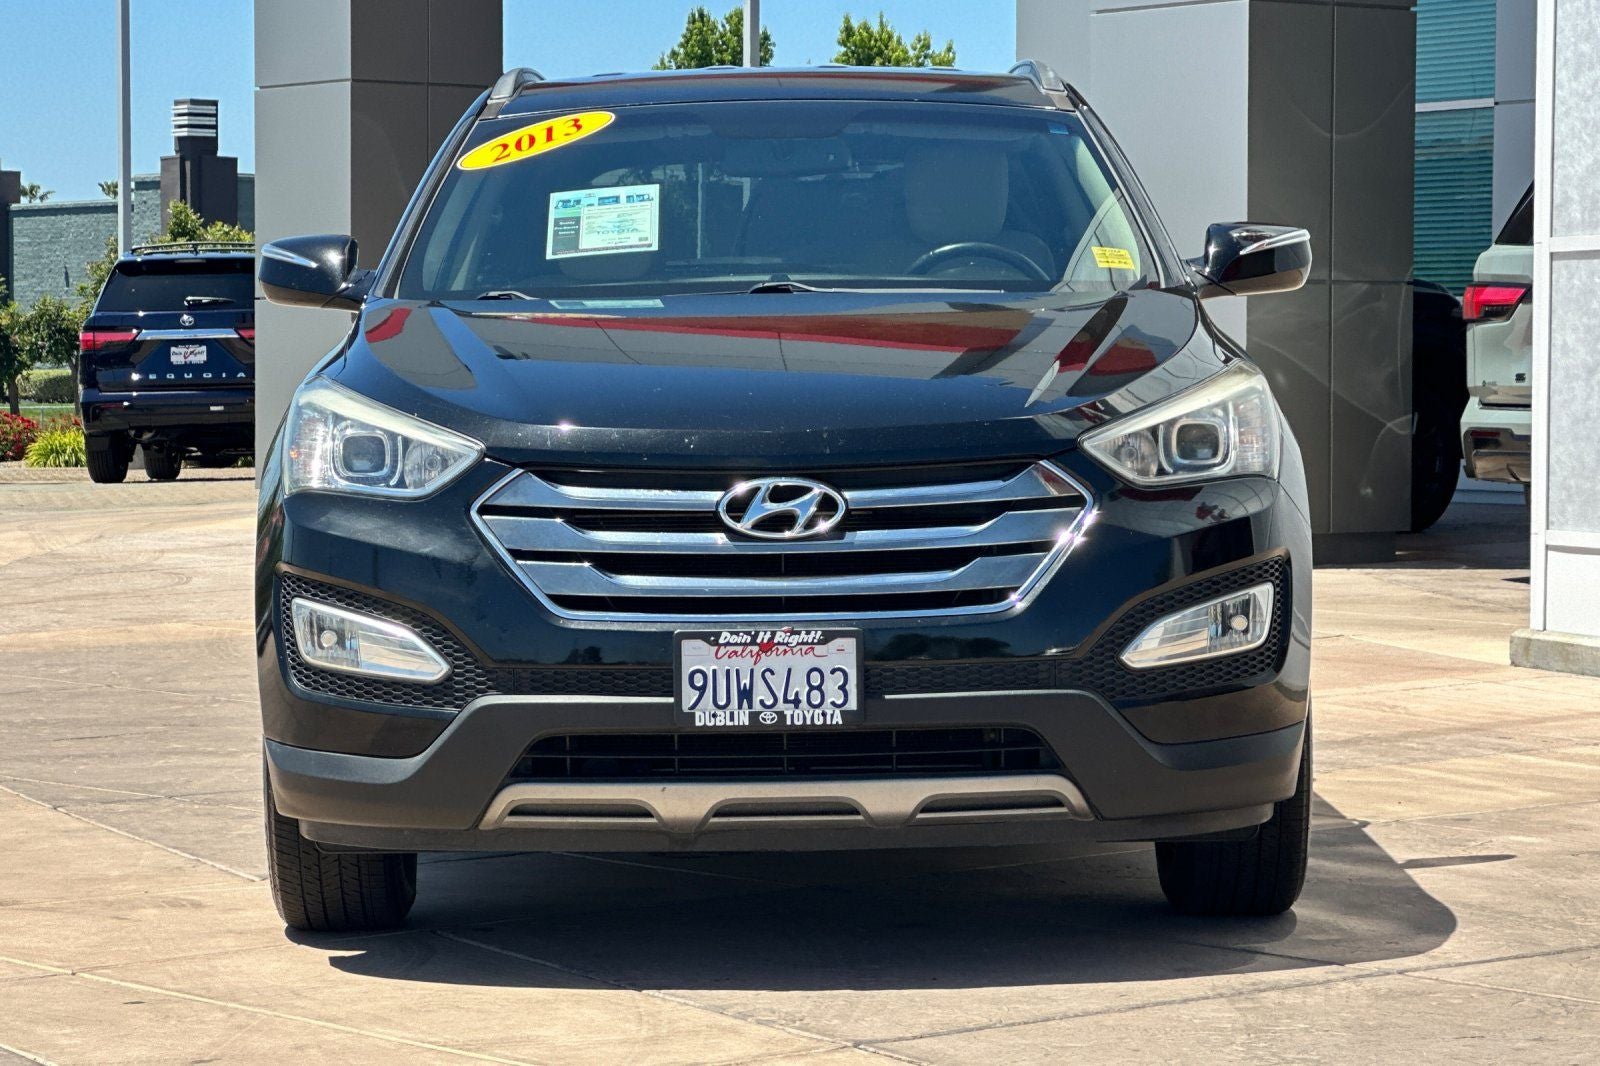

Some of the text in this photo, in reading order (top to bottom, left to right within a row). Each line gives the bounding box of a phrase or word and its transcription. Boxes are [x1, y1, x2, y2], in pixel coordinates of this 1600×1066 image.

[490, 118, 583, 162] 2013
[131, 371, 246, 381] EQUOIA
[756, 631, 773, 643] It
[714, 642, 828, 666] California
[687, 665, 850, 711] 9UWS483
[694, 709, 843, 727] DUBLIN TOYOTA
